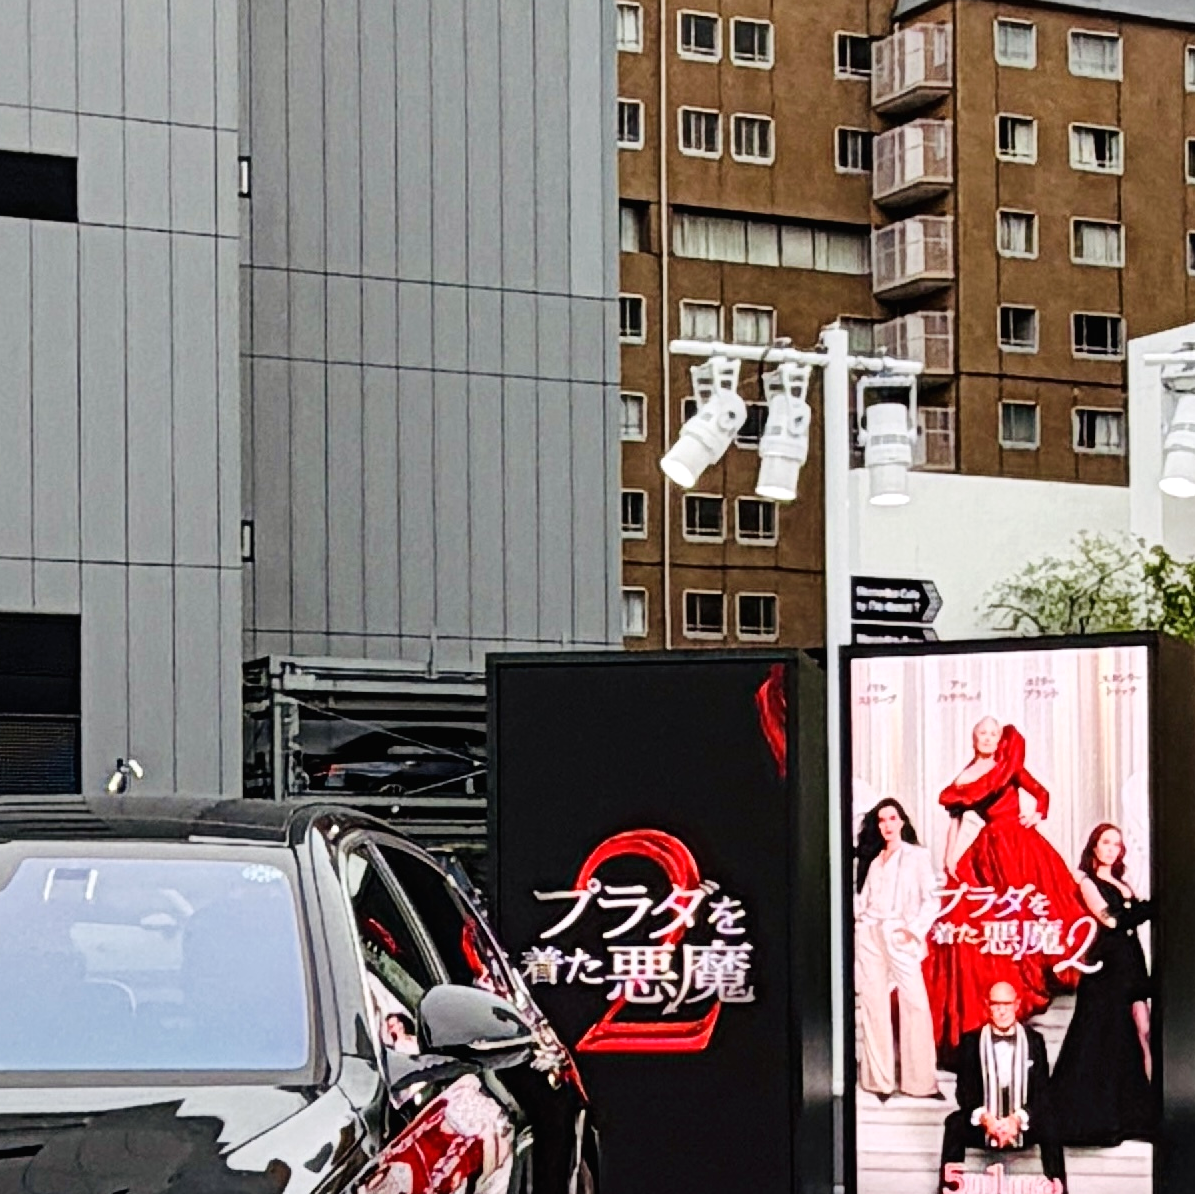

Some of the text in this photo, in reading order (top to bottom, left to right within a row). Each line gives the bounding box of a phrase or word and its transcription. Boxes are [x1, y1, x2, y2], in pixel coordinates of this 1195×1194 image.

[532, 877, 746, 940] プラダを
[931, 881, 1050, 918] プラダを
[520, 938, 756, 1016] 着た悪魔
